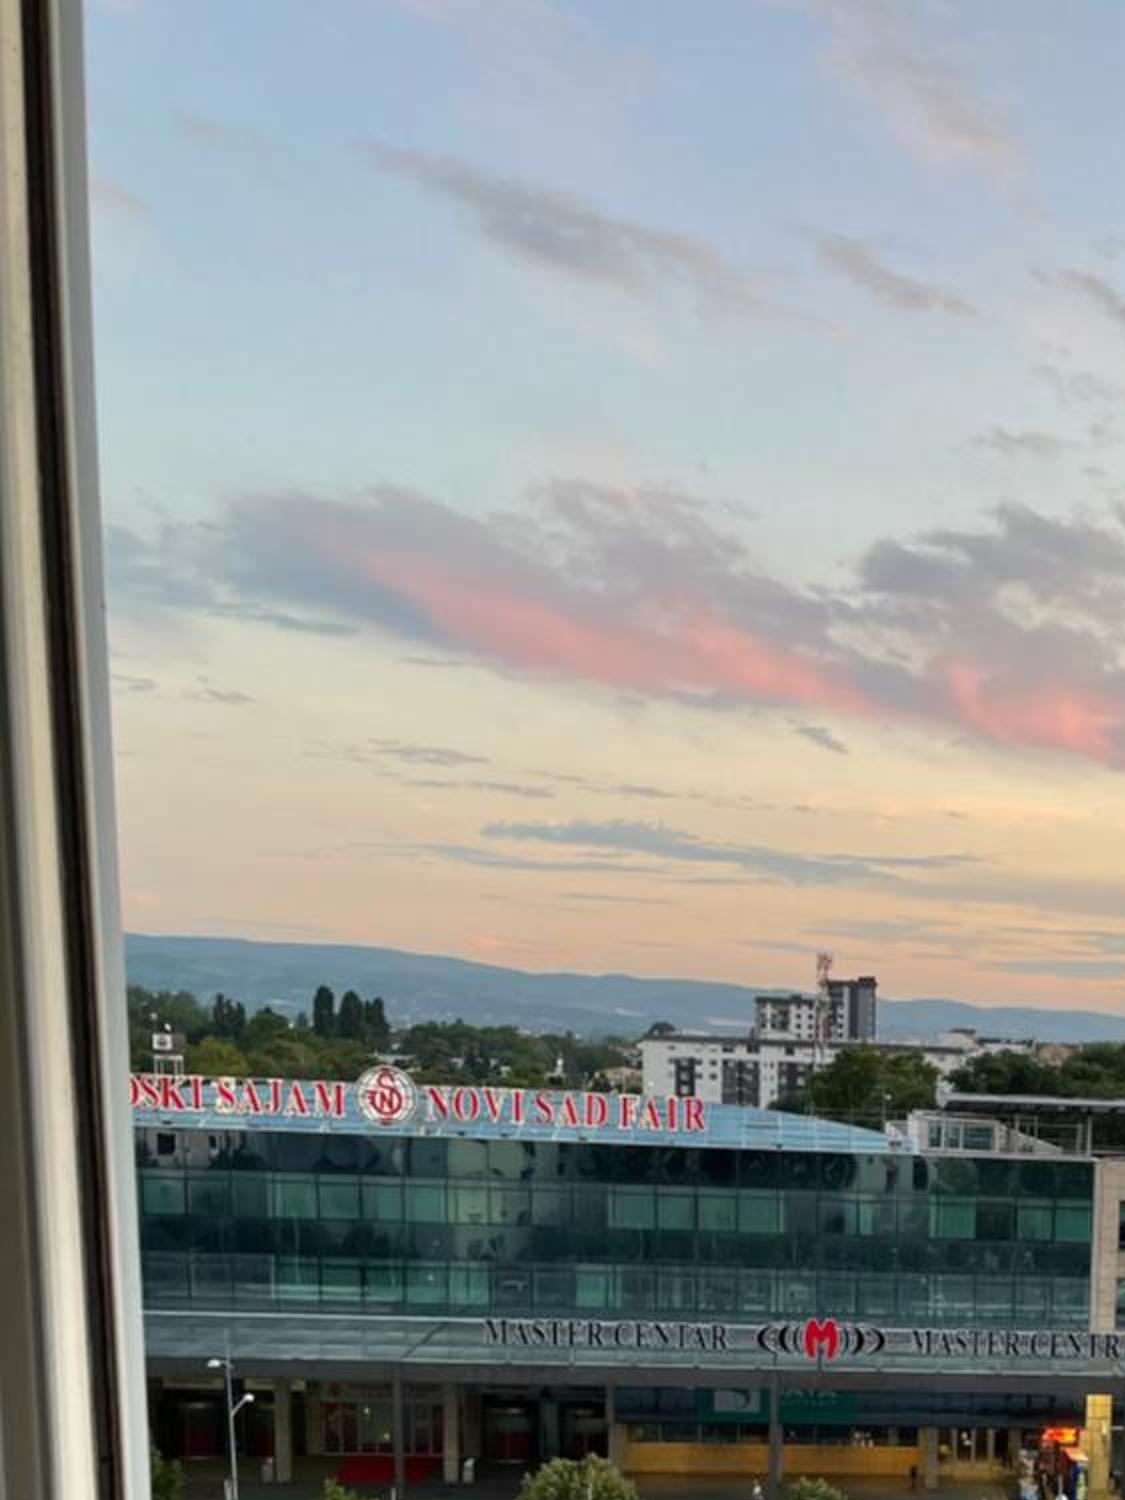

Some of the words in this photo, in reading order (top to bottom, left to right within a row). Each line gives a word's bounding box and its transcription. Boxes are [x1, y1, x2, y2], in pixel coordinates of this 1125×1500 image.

[215, 1076, 346, 1119] SAJAM
[425, 1086, 524, 1124] NOVI
[534, 1089, 608, 1128] SAD
[619, 1094, 706, 1132] FAIR
[482, 1320, 604, 1347] MASTER
[613, 1322, 729, 1350] CENTAR
[911, 1329, 1028, 1357] MASTER
